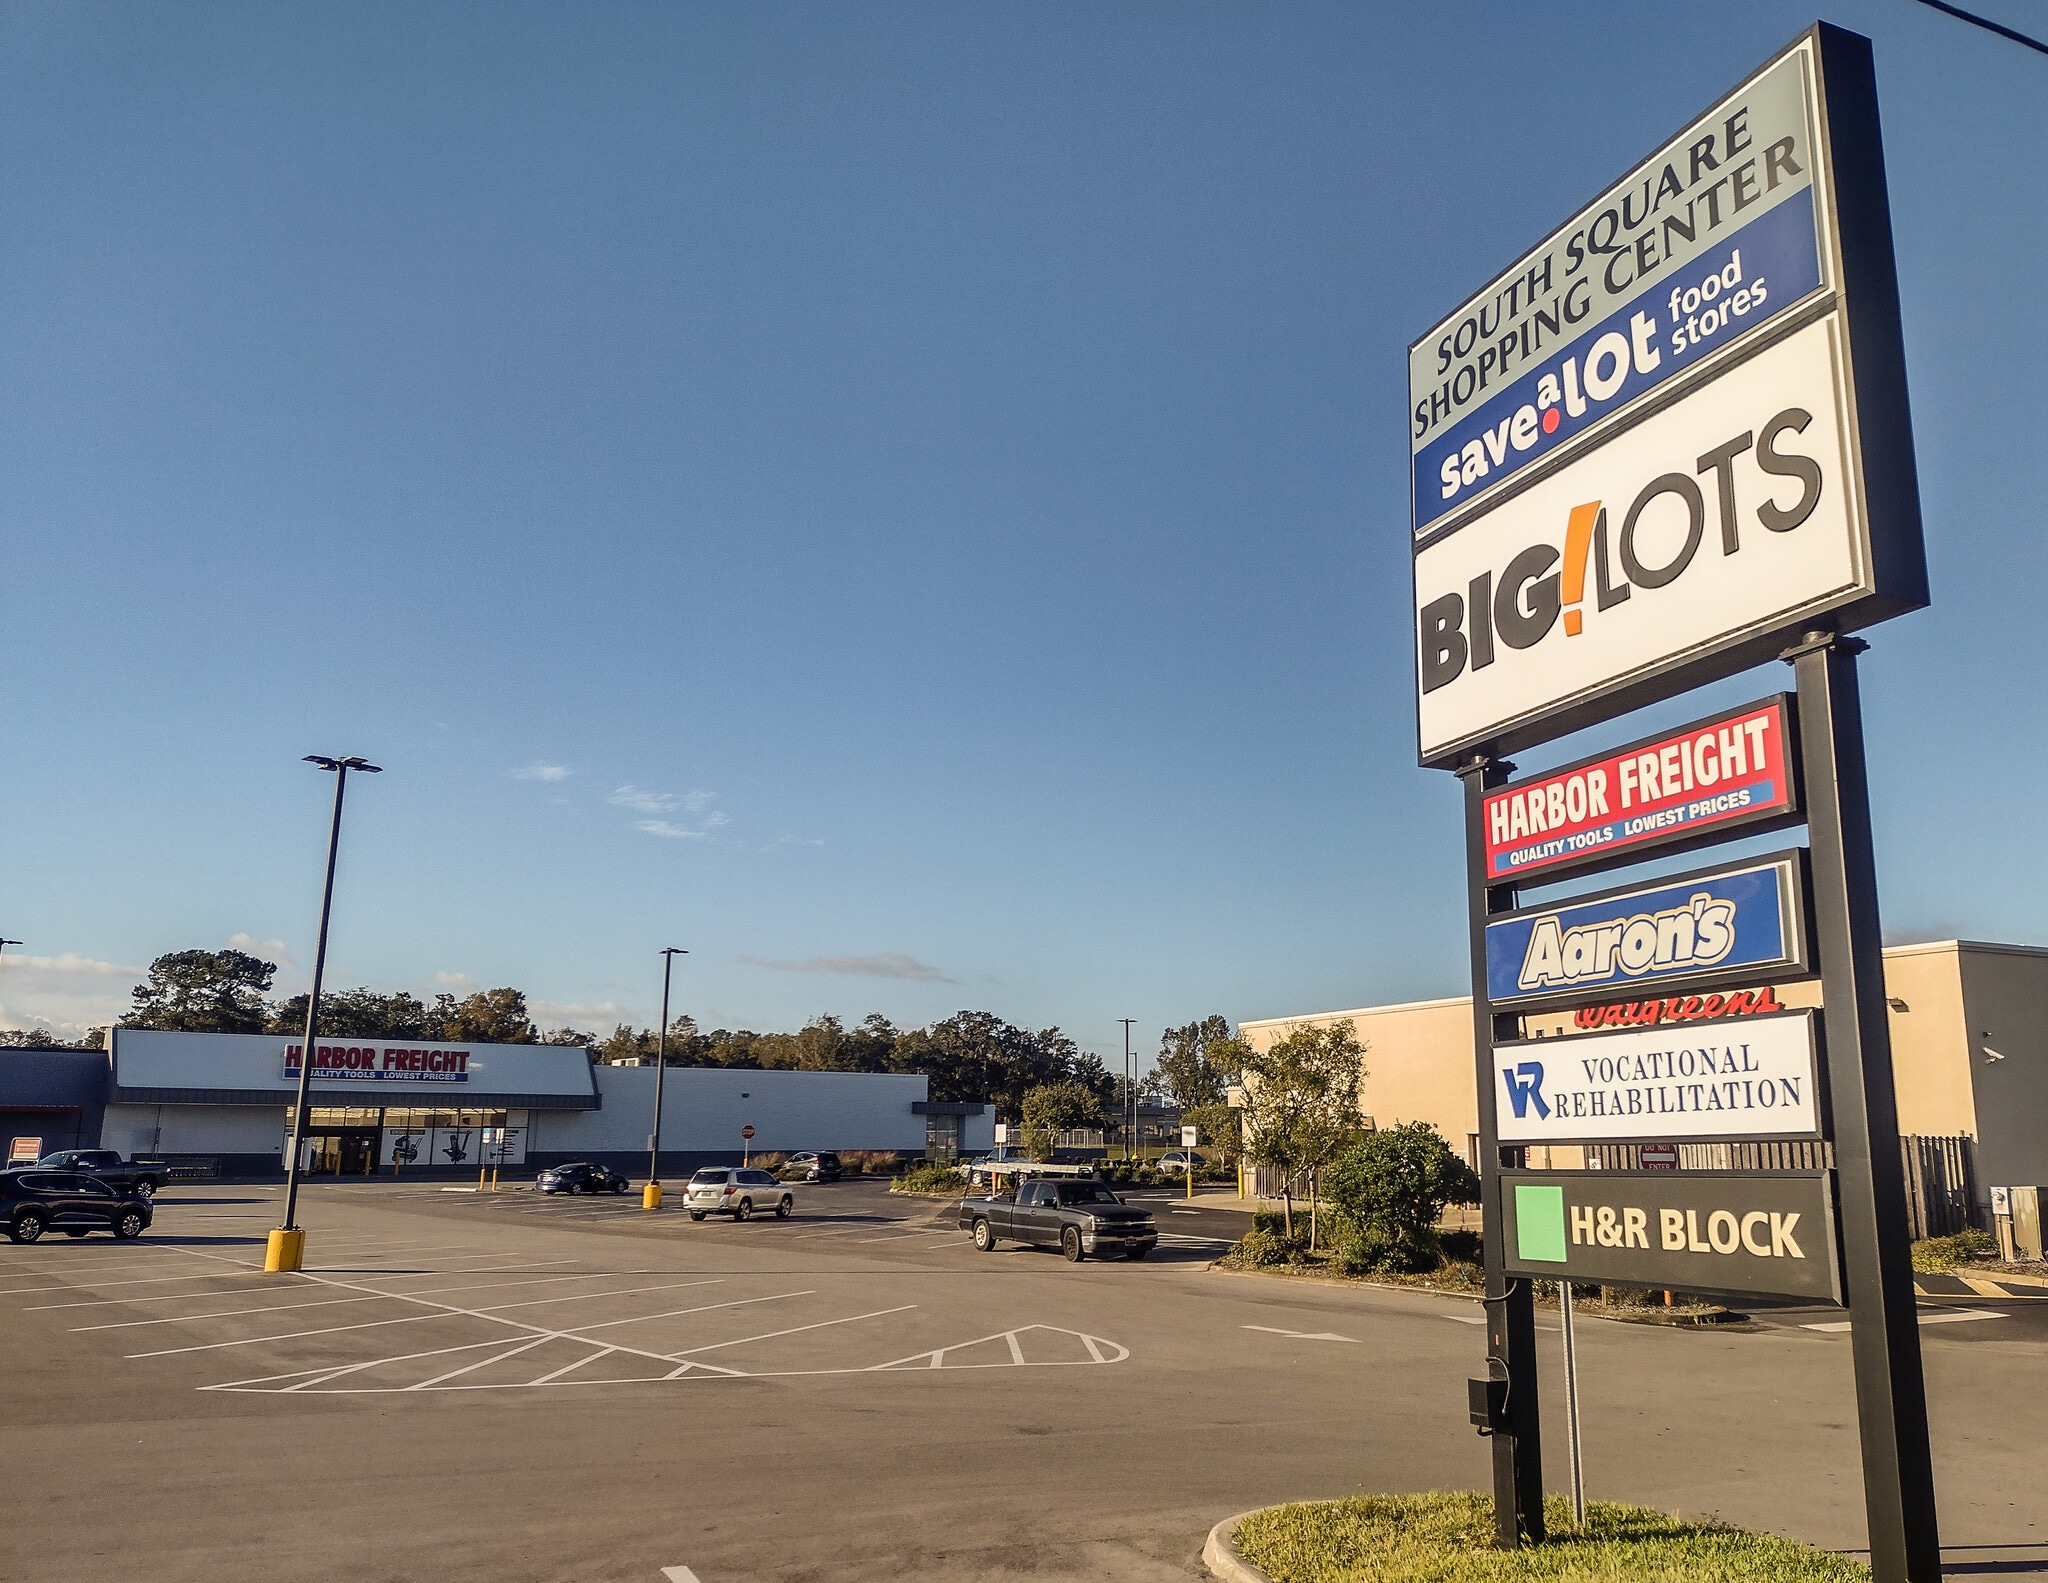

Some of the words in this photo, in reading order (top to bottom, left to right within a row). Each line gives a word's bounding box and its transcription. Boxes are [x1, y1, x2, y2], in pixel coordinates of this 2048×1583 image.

[1437, 252, 1553, 377] SOUTH
[1565, 105, 1753, 277] SQUARE
[1414, 281, 1591, 439] SHOPPING
[1603, 135, 1804, 295] CENTER
[1667, 249, 1743, 323] food
[1671, 276, 1768, 356] stores
[1440, 404, 1540, 500] save
[1489, 769, 1608, 846] HARBOR
[1618, 715, 1770, 809] FREIGHT
[1510, 839, 1566, 867] QUALITY
[1567, 826, 1614, 855] TOOLS
[1624, 807, 1686, 836] LOWEST
[1689, 789, 1751, 820] PRICES
[1518, 893, 1736, 991] Aaron's
[285, 1045, 376, 1070] HRBOR
[382, 1048, 470, 1072] FREIGHT
[299, 1069, 342, 1078] ALITY
[344, 1071, 376, 1079] TOOLS
[383, 1071, 421, 1080] LOWEST
[423, 1073, 457, 1081] PRICES
[1553, 1077, 1802, 1118] REHABILITATION
[1581, 1044, 1760, 1084] VOCATIONAL
[1570, 1206, 1650, 1250] H&R
[1659, 1207, 1806, 1260] BLOCK
